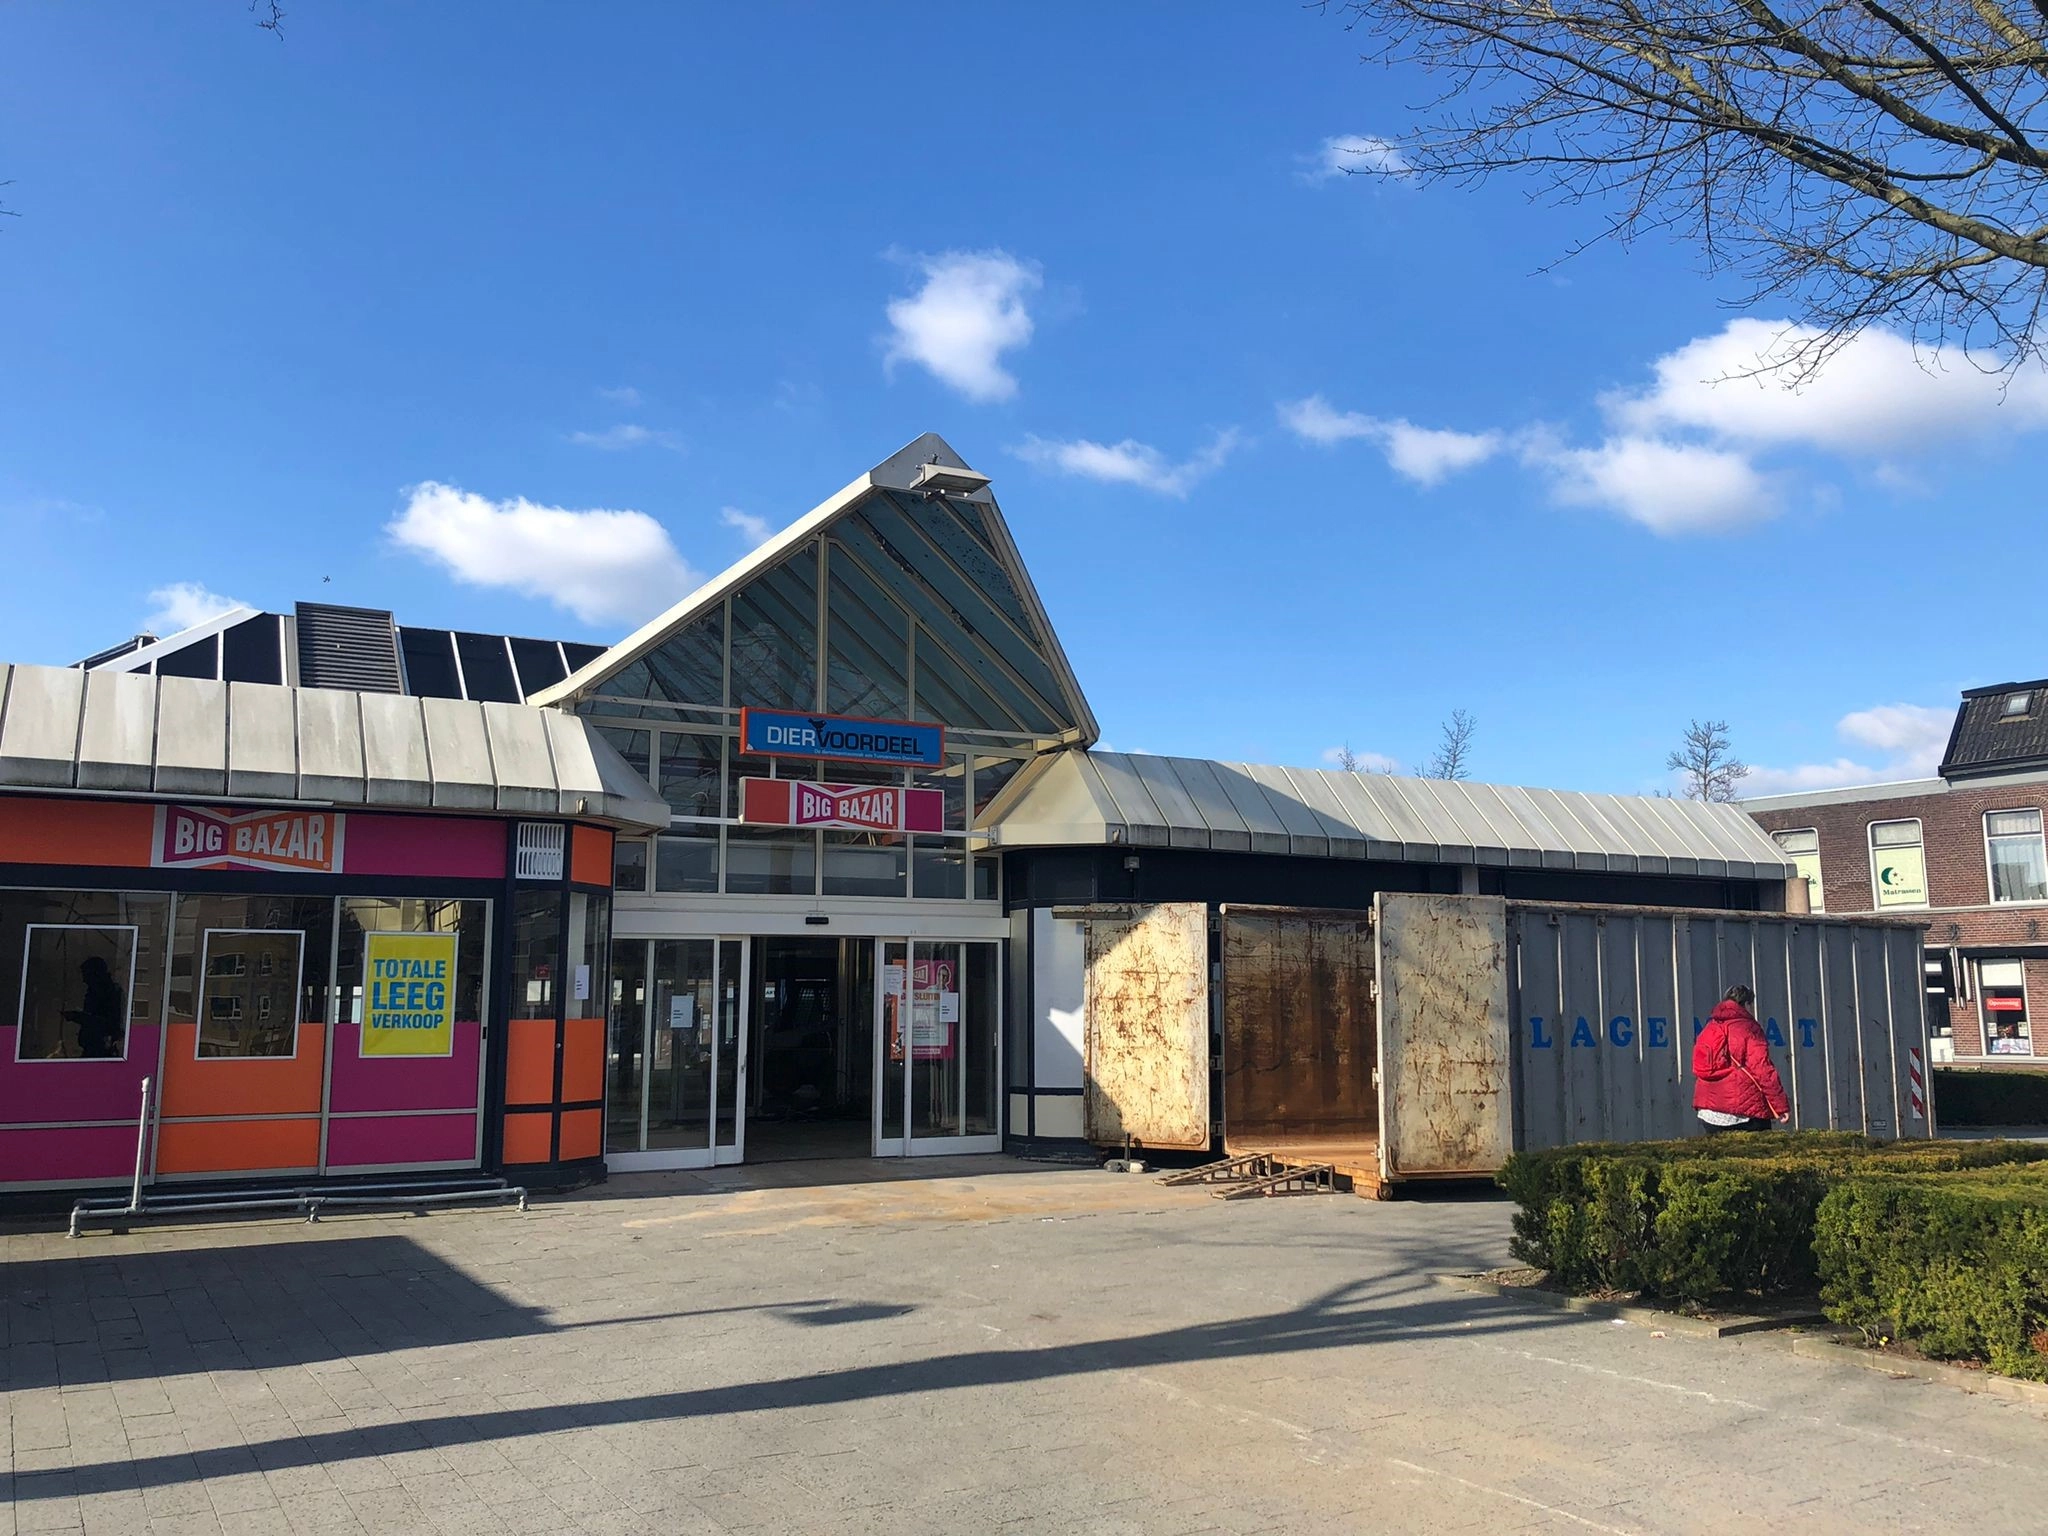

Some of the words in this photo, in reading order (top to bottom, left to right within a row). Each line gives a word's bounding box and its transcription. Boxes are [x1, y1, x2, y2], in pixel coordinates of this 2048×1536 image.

[767, 724, 924, 756] DIERVOORDEEL
[802, 791, 832, 819] BIG
[839, 791, 893, 825] BAZAR
[174, 815, 224, 854] BIG
[235, 814, 326, 861] BAZAR
[373, 959, 447, 979] TOTALE
[371, 981, 445, 1011] LEEG
[371, 1013, 444, 1029] VERKOOP
